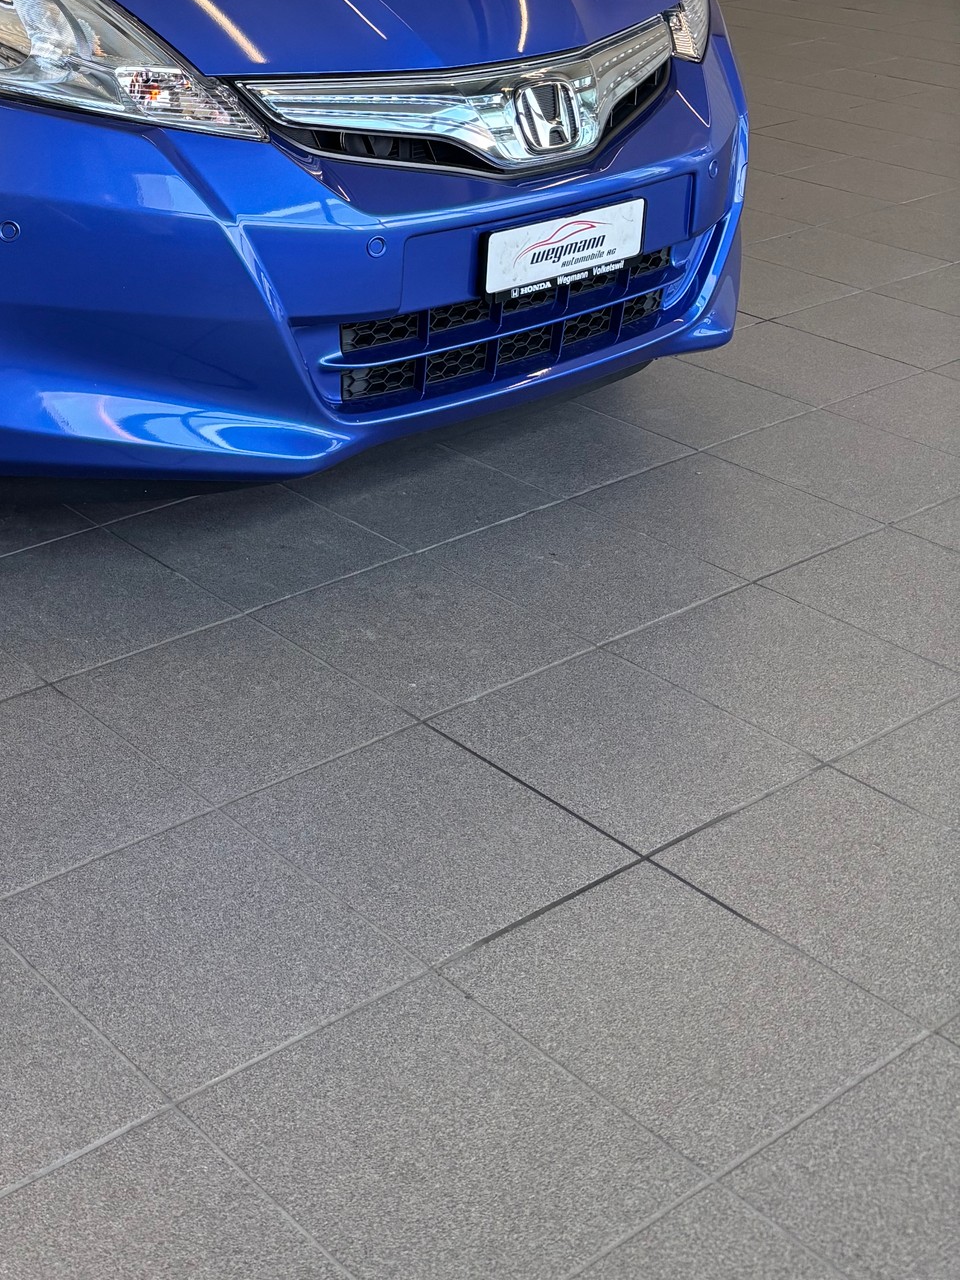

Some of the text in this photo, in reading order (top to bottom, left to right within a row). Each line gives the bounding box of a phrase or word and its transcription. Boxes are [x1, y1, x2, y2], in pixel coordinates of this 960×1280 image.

[529, 234, 607, 265] wegmann
[520, 281, 552, 295] HONDA
[556, 271, 589, 286] Wegmann
